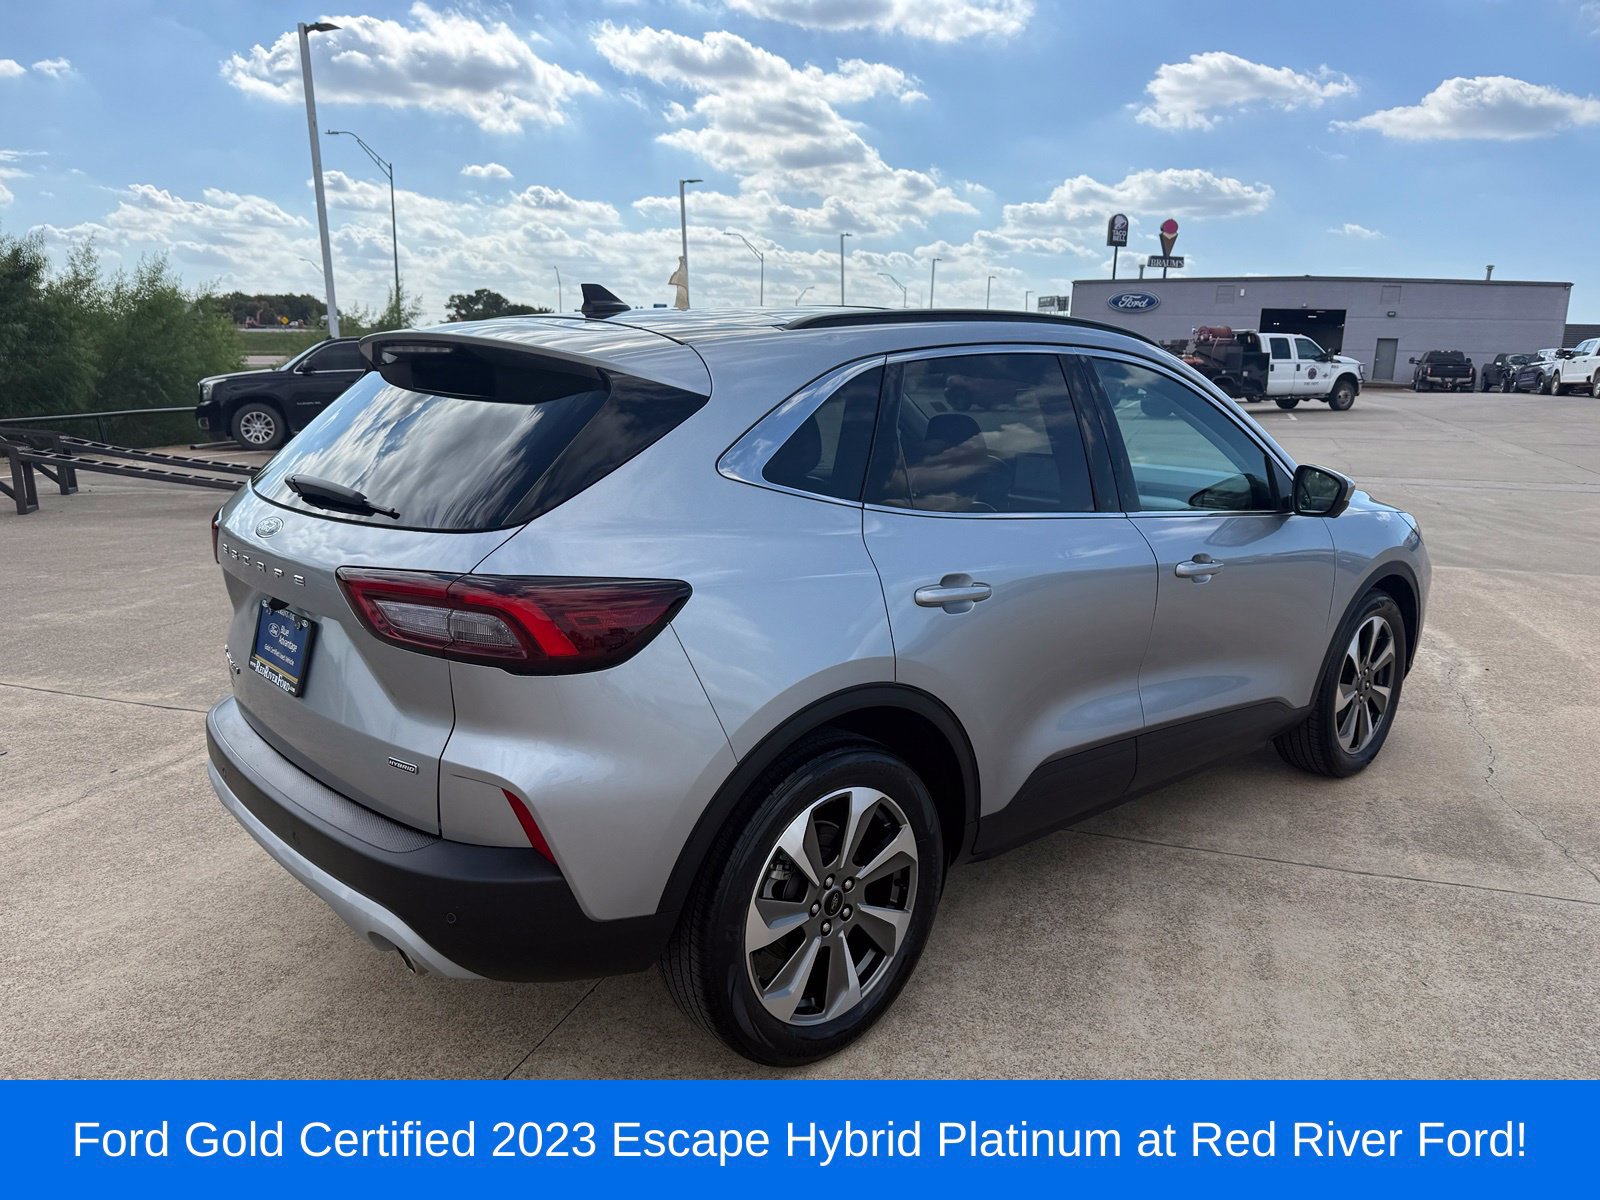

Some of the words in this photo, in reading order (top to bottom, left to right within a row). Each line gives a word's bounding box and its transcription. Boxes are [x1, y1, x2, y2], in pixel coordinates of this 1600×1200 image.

[1150, 258, 1184, 267] BRAUM'S
[1118, 294, 1149, 308] Ford
[222, 543, 306, 587] ESCAPE
[280, 625, 290, 637] Blue
[388, 759, 415, 772] HYBRID
